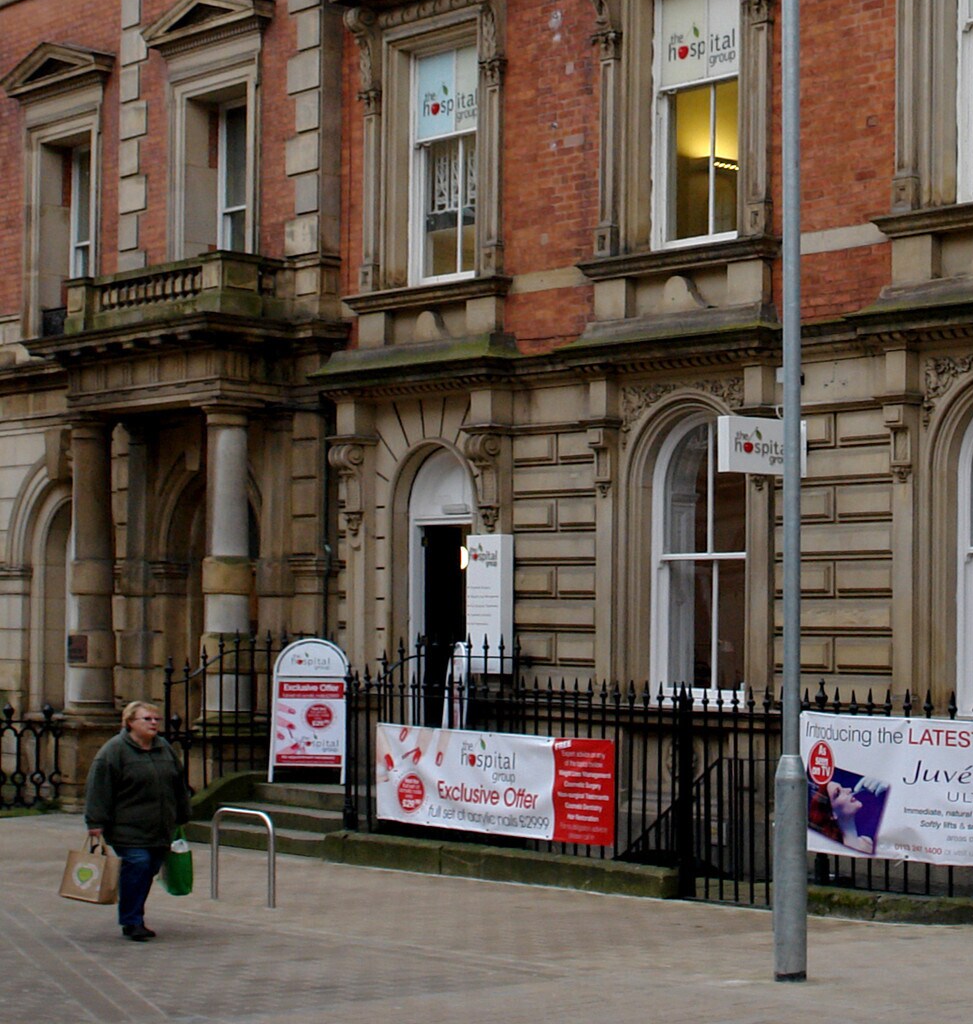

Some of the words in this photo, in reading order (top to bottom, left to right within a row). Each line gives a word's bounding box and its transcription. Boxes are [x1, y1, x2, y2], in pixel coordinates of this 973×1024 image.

[670, 32, 684, 44] the
[668, 27, 735, 62] hospital
[709, 50, 736, 68] group
[424, 91, 436, 101] the
[736, 431, 749, 440] the
[734, 437, 784, 457] hospita
[769, 456, 784, 465] gro
[806, 721, 872, 747] Introducing
[878, 727, 903, 744] the
[462, 740, 473, 751] the
[818, 744, 827, 756] As
[460, 748, 516, 771] hospital
[821, 765, 831, 777] TV
[492, 771, 516, 784] group
[437, 780, 500, 805] Exclusive
[503, 787, 538, 810] Offer
[428, 804, 441, 818] full
[443, 808, 455, 819] set
[456, 808, 466, 821] of
[497, 814, 518, 827] nails
[904, 807, 944, 818] Immediate,
[946, 810, 972, 818] natural
[920, 820, 942, 830] Softly
[943, 821, 957, 829] lifts
